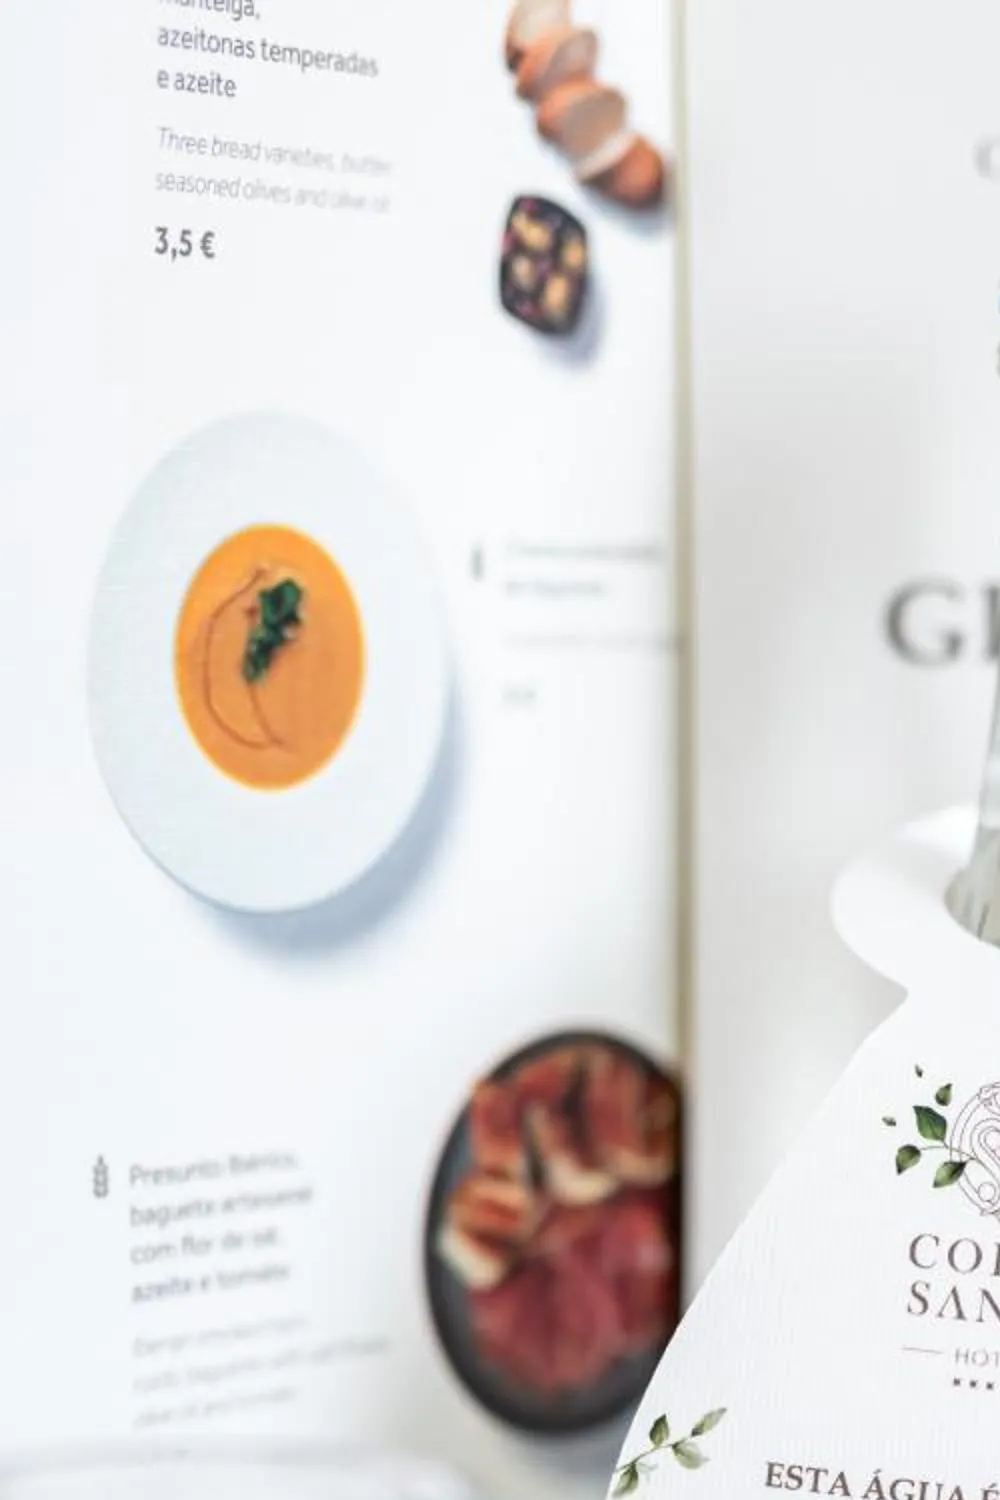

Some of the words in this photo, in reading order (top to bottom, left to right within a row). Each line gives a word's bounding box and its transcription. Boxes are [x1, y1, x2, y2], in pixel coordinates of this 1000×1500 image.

[156, 25, 256, 60] azeitonas
[260, 37, 380, 78] temperadas
[156, 68, 170, 90] e
[174, 71, 238, 98] azeite
[157, 126, 208, 156] Three
[211, 136, 262, 162] bread
[154, 170, 241, 200] seasoned
[153, 225, 193, 263] 3,5
[199, 230, 218, 260] €
[764, 1461, 850, 1498] ESTA
